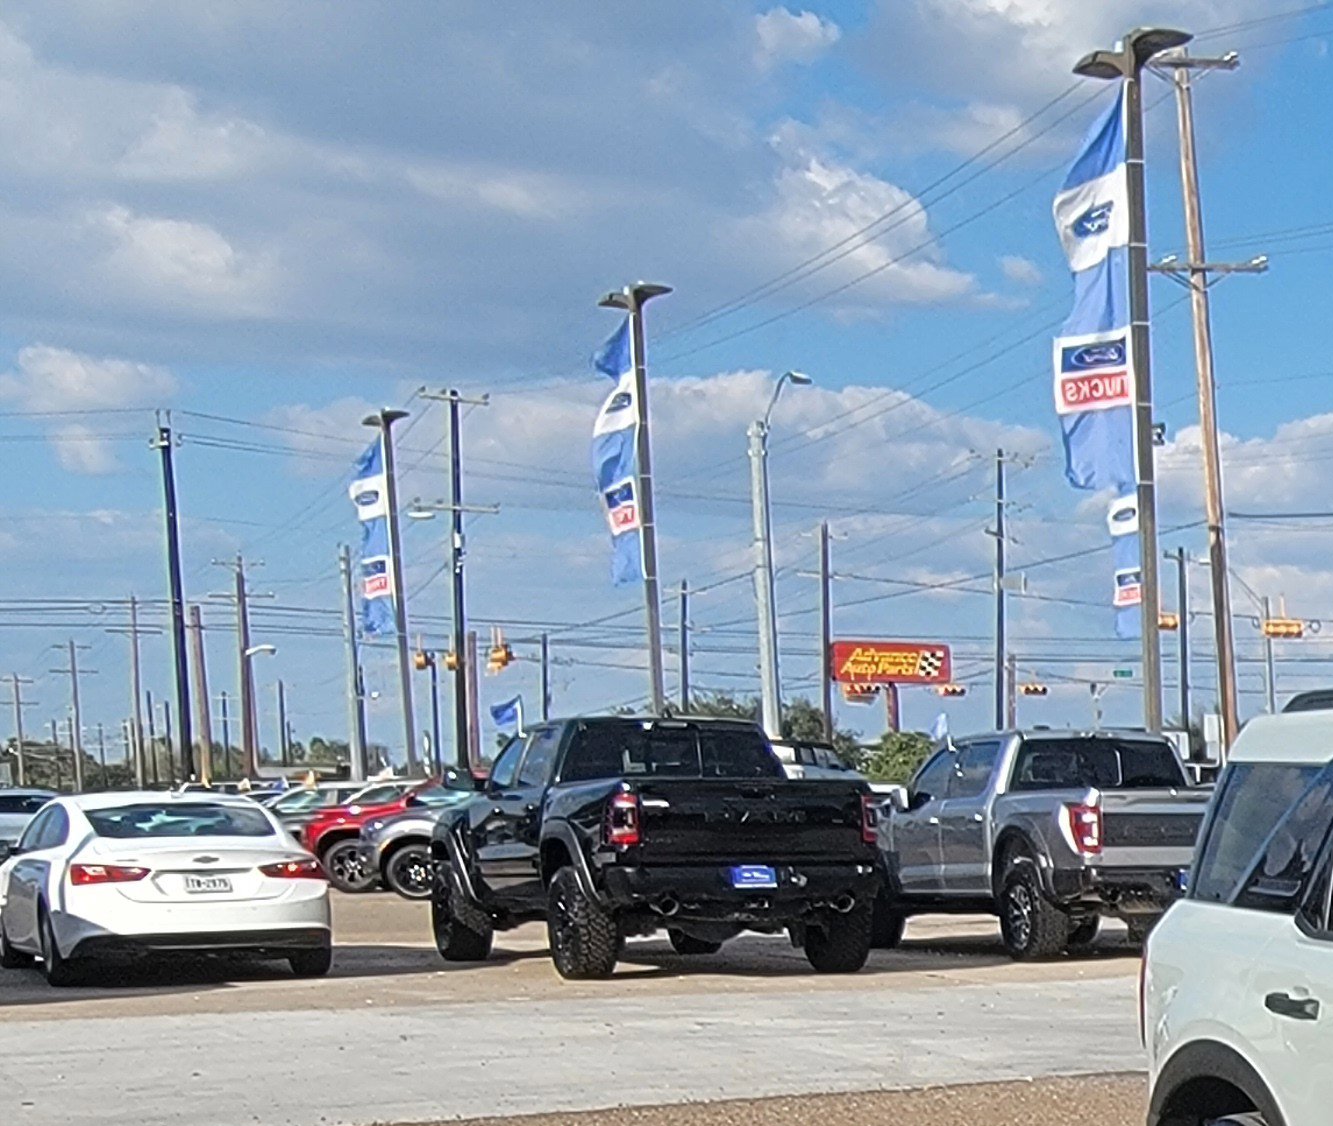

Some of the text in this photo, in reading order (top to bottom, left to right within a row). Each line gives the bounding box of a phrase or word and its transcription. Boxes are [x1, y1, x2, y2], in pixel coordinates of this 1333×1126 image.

[849, 648, 917, 662] Advance
[840, 661, 915, 675] Auto Parts
